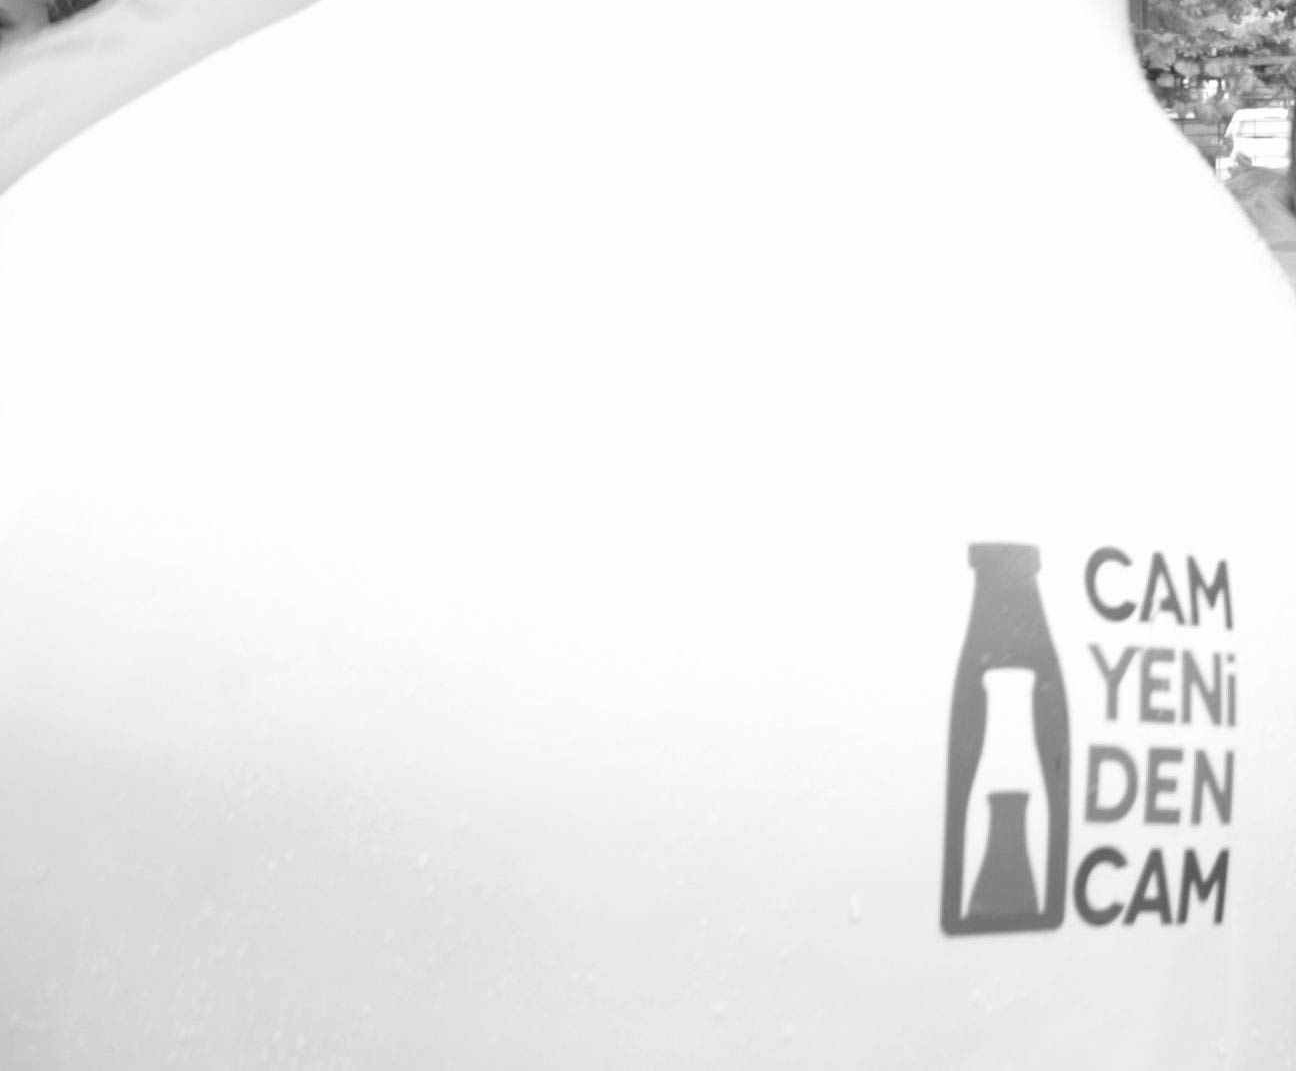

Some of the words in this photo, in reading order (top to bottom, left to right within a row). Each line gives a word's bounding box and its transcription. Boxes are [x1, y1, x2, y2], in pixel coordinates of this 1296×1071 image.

[1084, 546, 1233, 631] CAM
[1084, 745, 1235, 826] DEN
[1073, 845, 1230, 927] CAM
